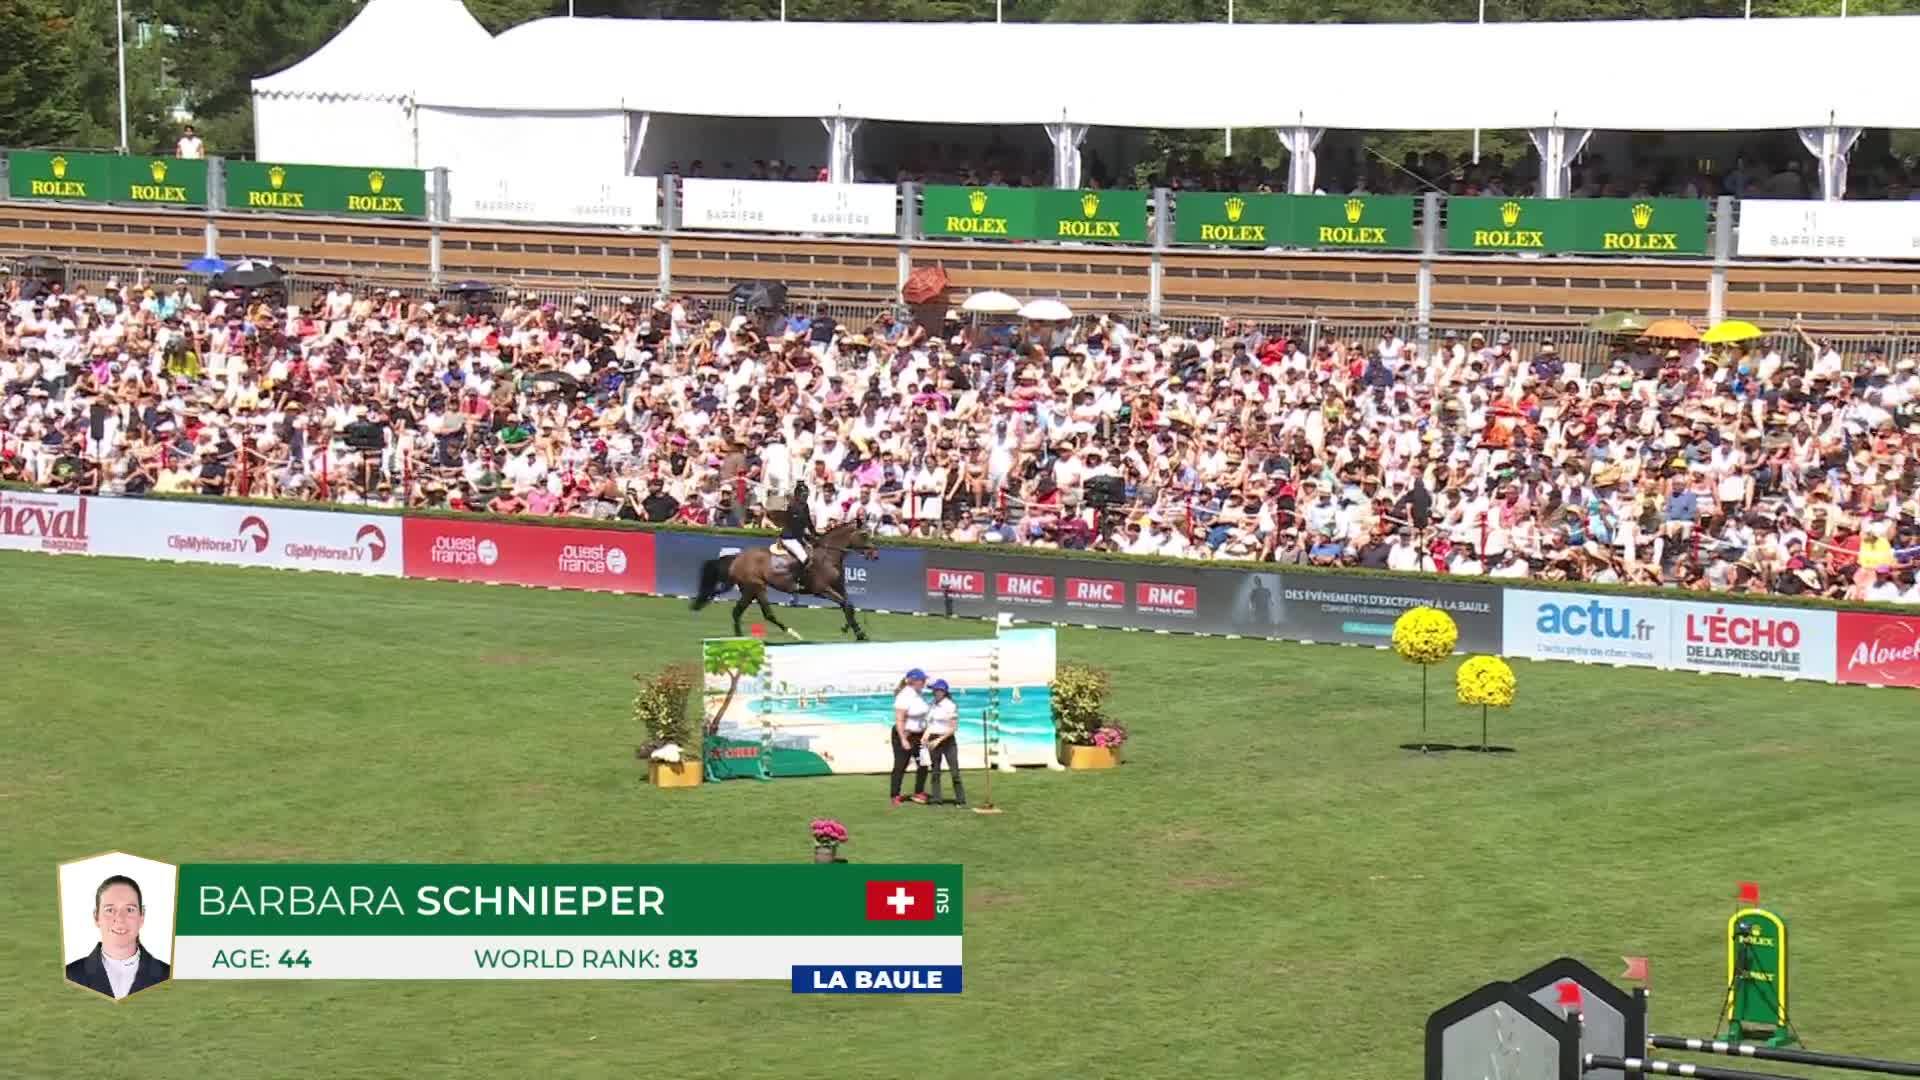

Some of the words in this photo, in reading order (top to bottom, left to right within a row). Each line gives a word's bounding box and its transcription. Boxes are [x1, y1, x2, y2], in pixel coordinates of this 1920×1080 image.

[32, 180, 87, 198] ROLEX
[131, 185, 186, 202] ROLEX
[249, 191, 304, 208] ROLEX
[349, 195, 404, 213] ROLEX
[946, 216, 1007, 235] ROLEX
[1058, 220, 1121, 238] ROLEX
[1201, 224, 1265, 242] ROLEX
[1319, 226, 1387, 245] ROLEX
[1473, 230, 1544, 248] ROLEX
[1604, 232, 1677, 251] ROLEX
[168, 535, 248, 553] ClipMyHorse.TV
[285, 543, 364, 561] ClipMyHorse.TV
[435, 535, 476, 551] ouest
[563, 543, 605, 560] ouest
[431, 545, 477, 565] france
[559, 554, 605, 574] france
[1007, 577, 1043, 595] RMC
[1077, 582, 1114, 600] RMC
[1148, 587, 1185, 605] RMC
[1536, 599, 1655, 641] actu.fr
[1686, 607, 1800, 649] L'ÉCHO
[1687, 645, 1704, 657] DE
[1705, 646, 1722, 659] LA
